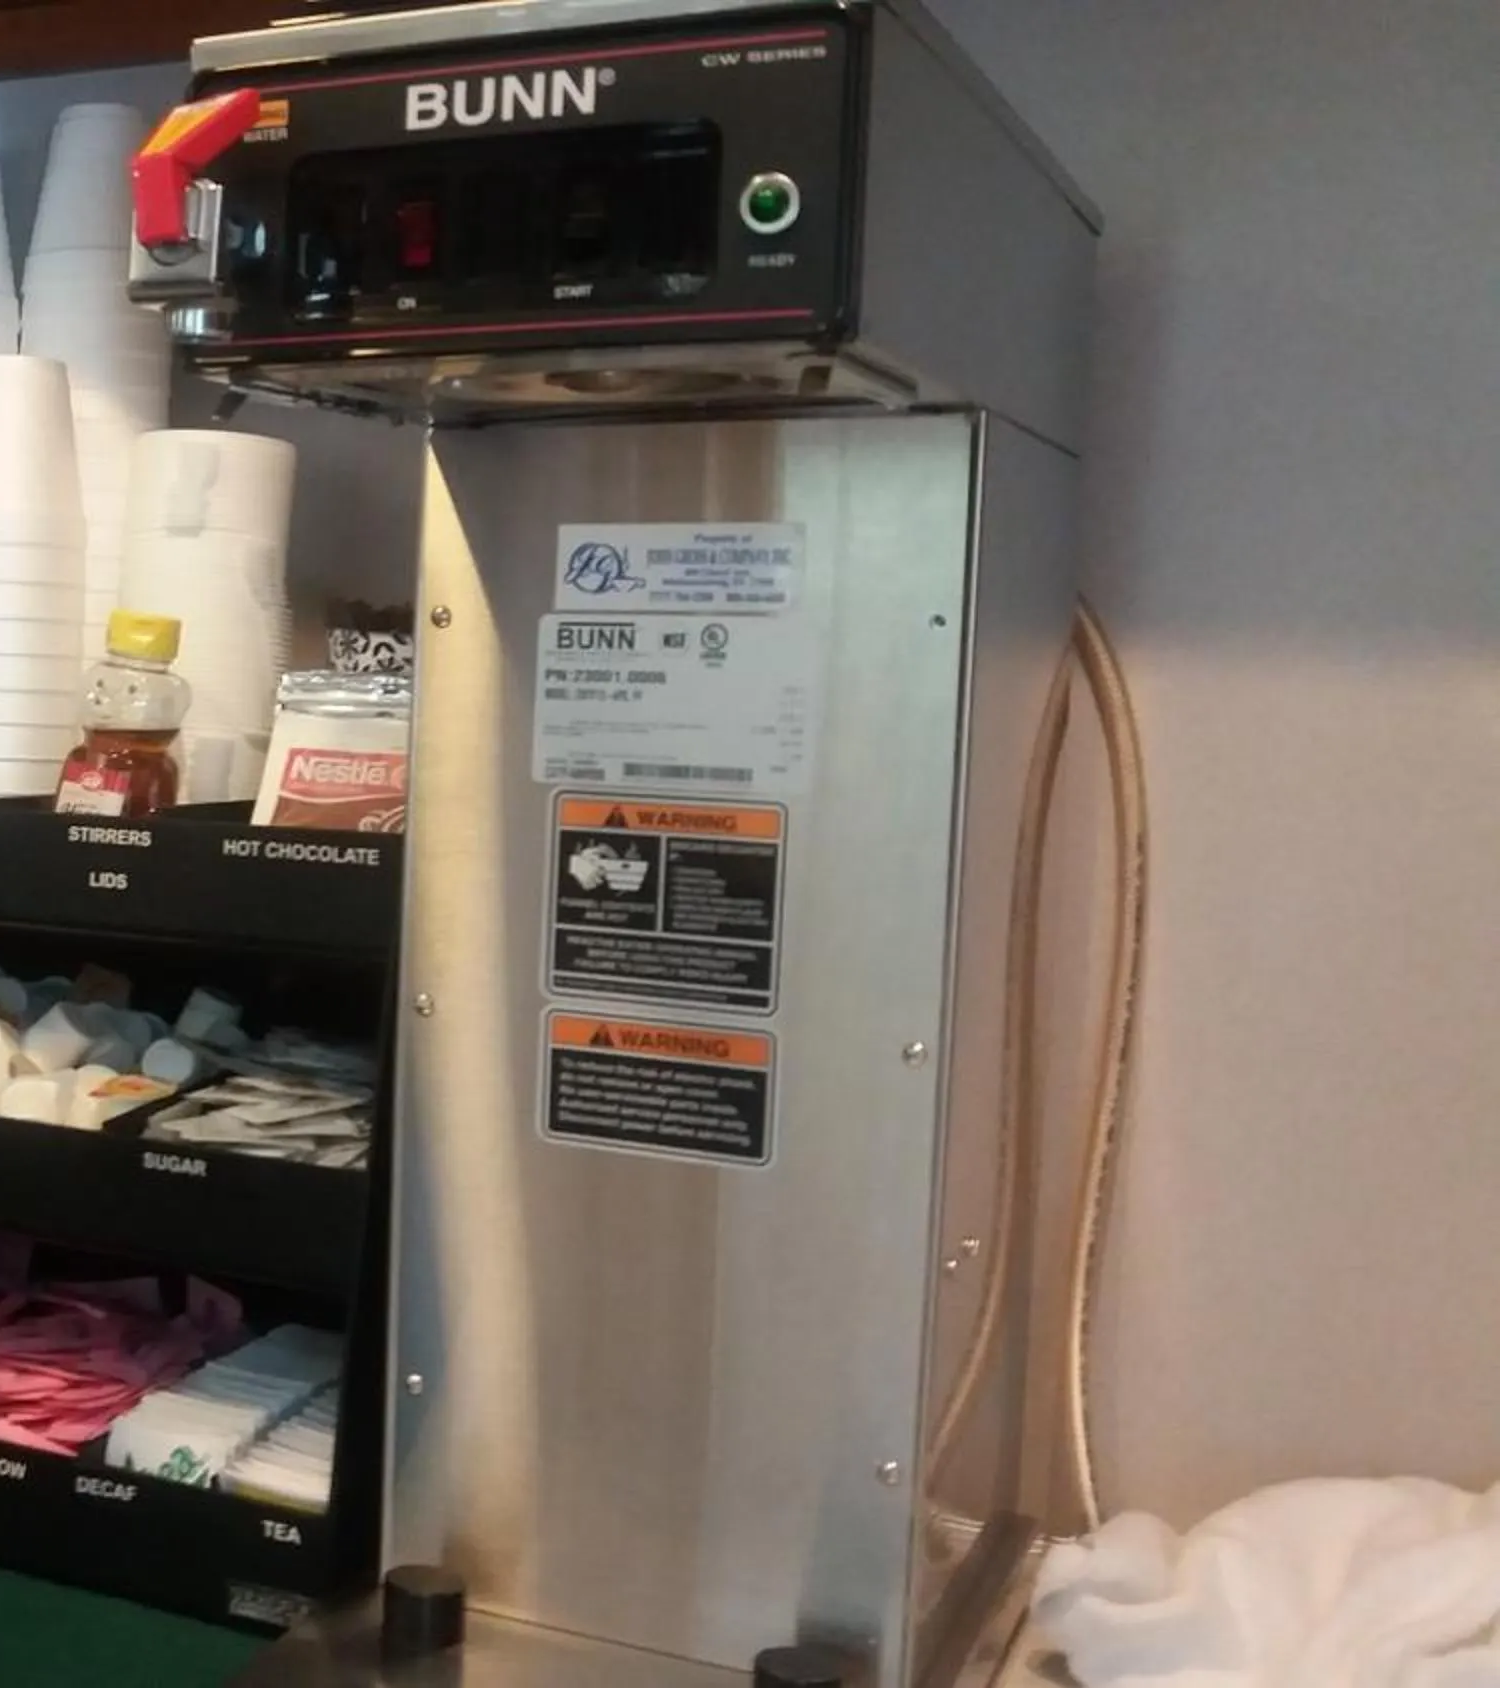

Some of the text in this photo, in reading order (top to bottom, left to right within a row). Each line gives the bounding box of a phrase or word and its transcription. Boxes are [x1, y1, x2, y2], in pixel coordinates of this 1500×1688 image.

[702, 45, 827, 67] CW SERIES
[553, 284, 593, 299] START
[556, 627, 636, 651] BUNN
[636, 810, 738, 833] WARNING
[68, 825, 152, 847] STIRRERS
[223, 839, 380, 866] HOT CHOCOLATE
[89, 871, 128, 890] LIDS
[617, 1028, 731, 1058] WARNING
[142, 1150, 207, 1178] SUGAR
[76, 1476, 137, 1503] DECAF
[261, 1519, 301, 1545] TEA
